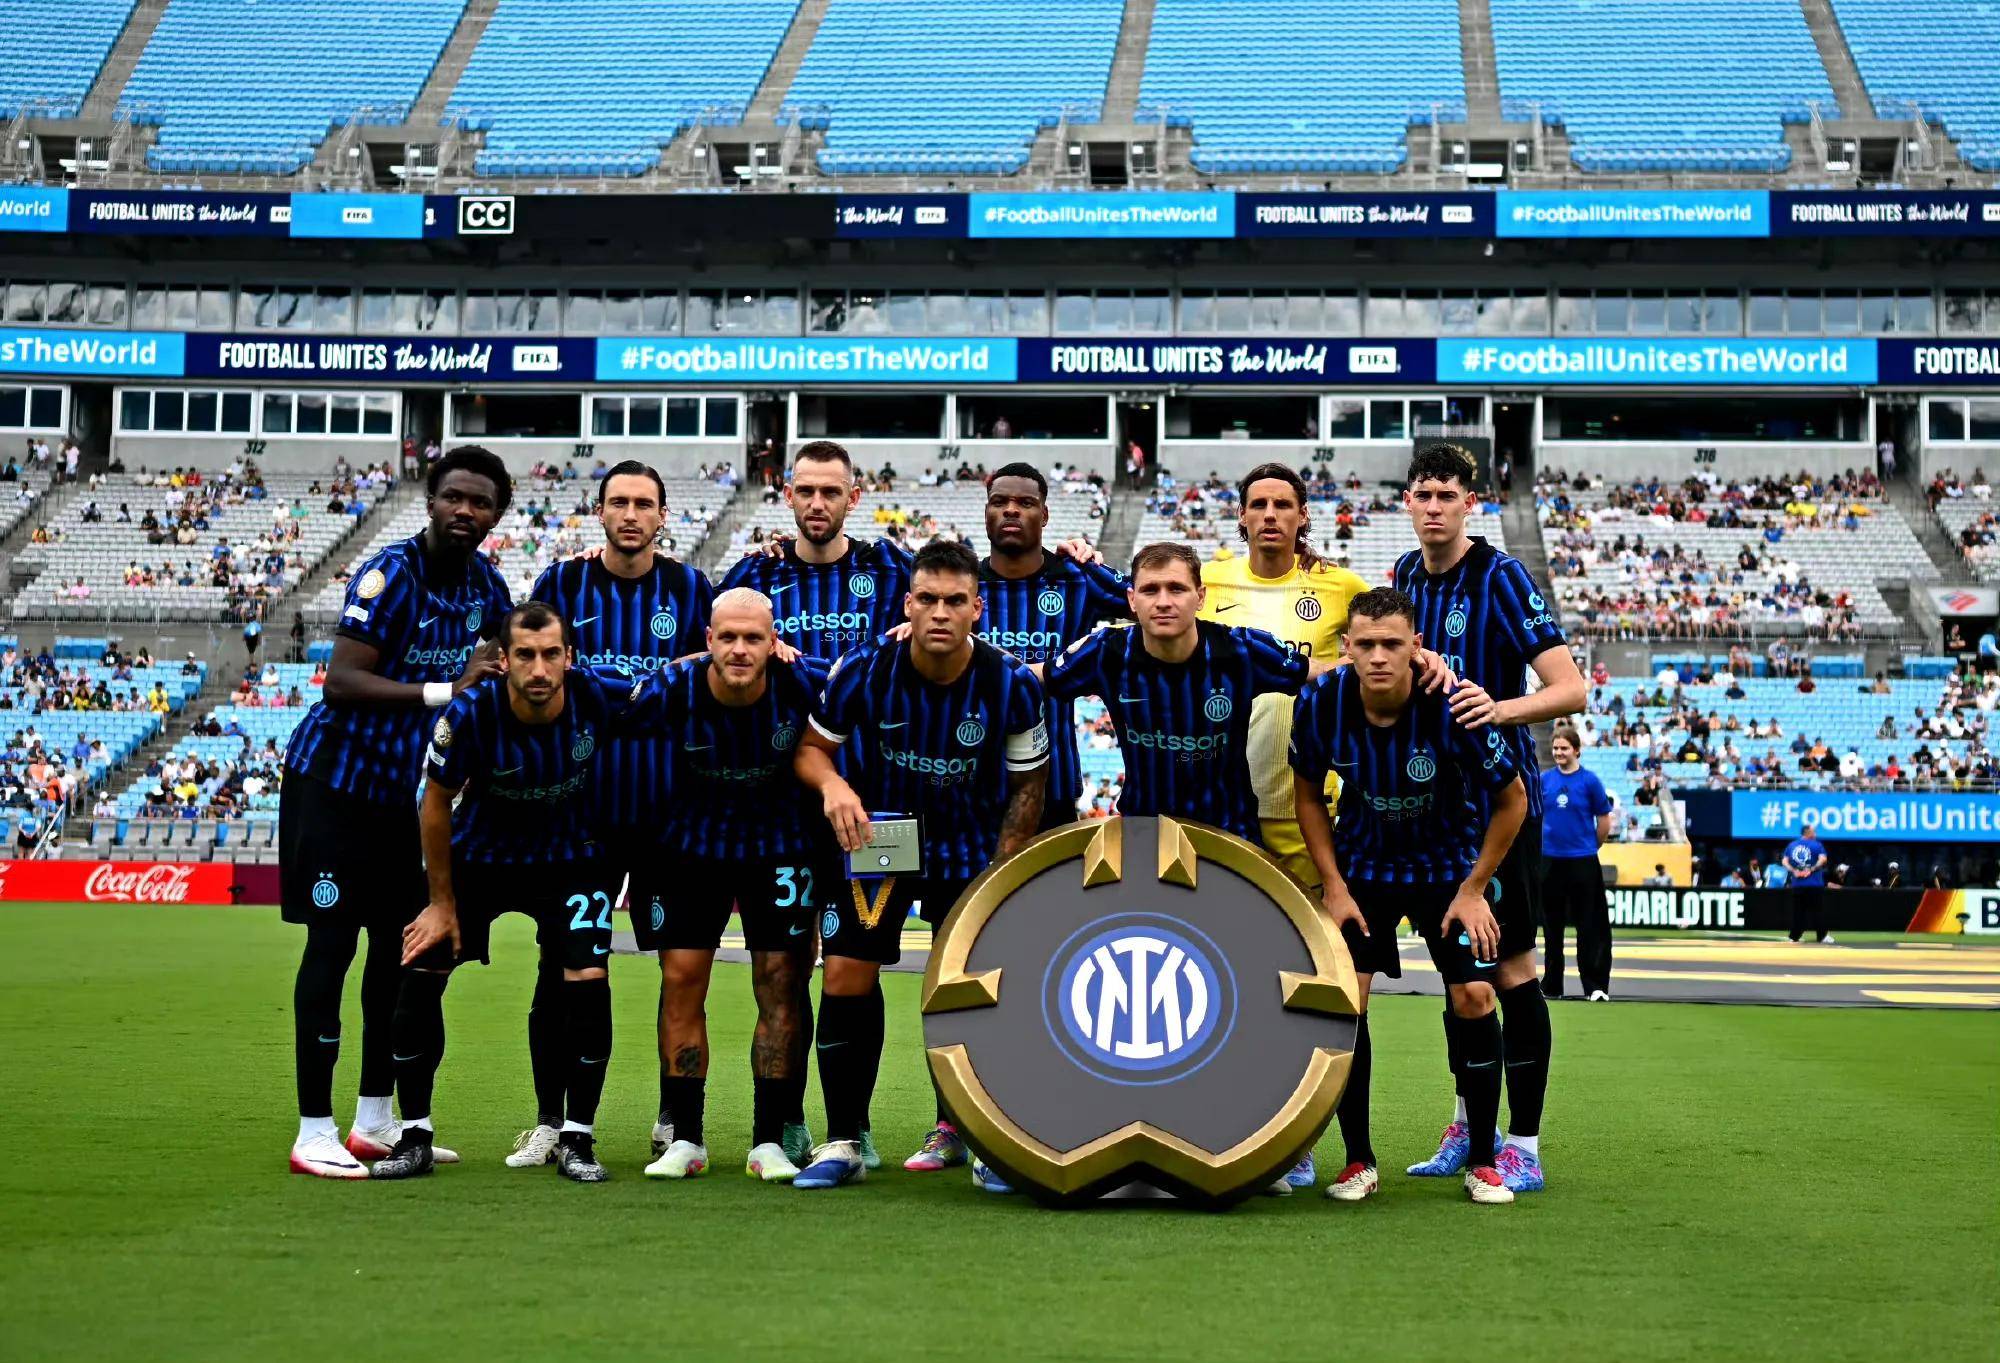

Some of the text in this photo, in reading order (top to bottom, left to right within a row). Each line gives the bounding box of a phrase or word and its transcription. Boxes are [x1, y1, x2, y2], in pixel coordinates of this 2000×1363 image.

[89, 202, 257, 223] FOOTBALL UNITES the World
[466, 202, 506, 227] CC
[843, 206, 863, 224] the
[864, 207, 903, 225] World
[985, 206, 1217, 223] #FootballUnitesTheWorld
[1256, 205, 1429, 224] FOOTBALL UNITES the World
[1512, 204, 1752, 222] #FootballUnitesTheWorld
[1792, 203, 1855, 222] FOOTBALL
[1857, 203, 1902, 222] UNITES
[1906, 203, 1928, 221] the
[1929, 203, 1969, 222] World
[219, 342, 492, 373] FOOTBALL UNITES the World
[521, 352, 551, 364] FIFA
[621, 344, 989, 372] #FootballUnitesTheWorld
[1051, 345, 1327, 374] FOOTBALL UNITES the World
[1358, 353, 1388, 365] FIFA
[1462, 345, 1848, 374] #FootballUnitesTheWorld
[244, 440, 267, 455] 312
[572, 443, 594, 458] 313
[977, 626, 1061, 648] etsson
[1125, 724, 1228, 751] betsson
[879, 740, 978, 775] betsson
[85, 863, 196, 901] Coca-Cola
[774, 866, 814, 907] 32
[565, 890, 612, 930] 22
